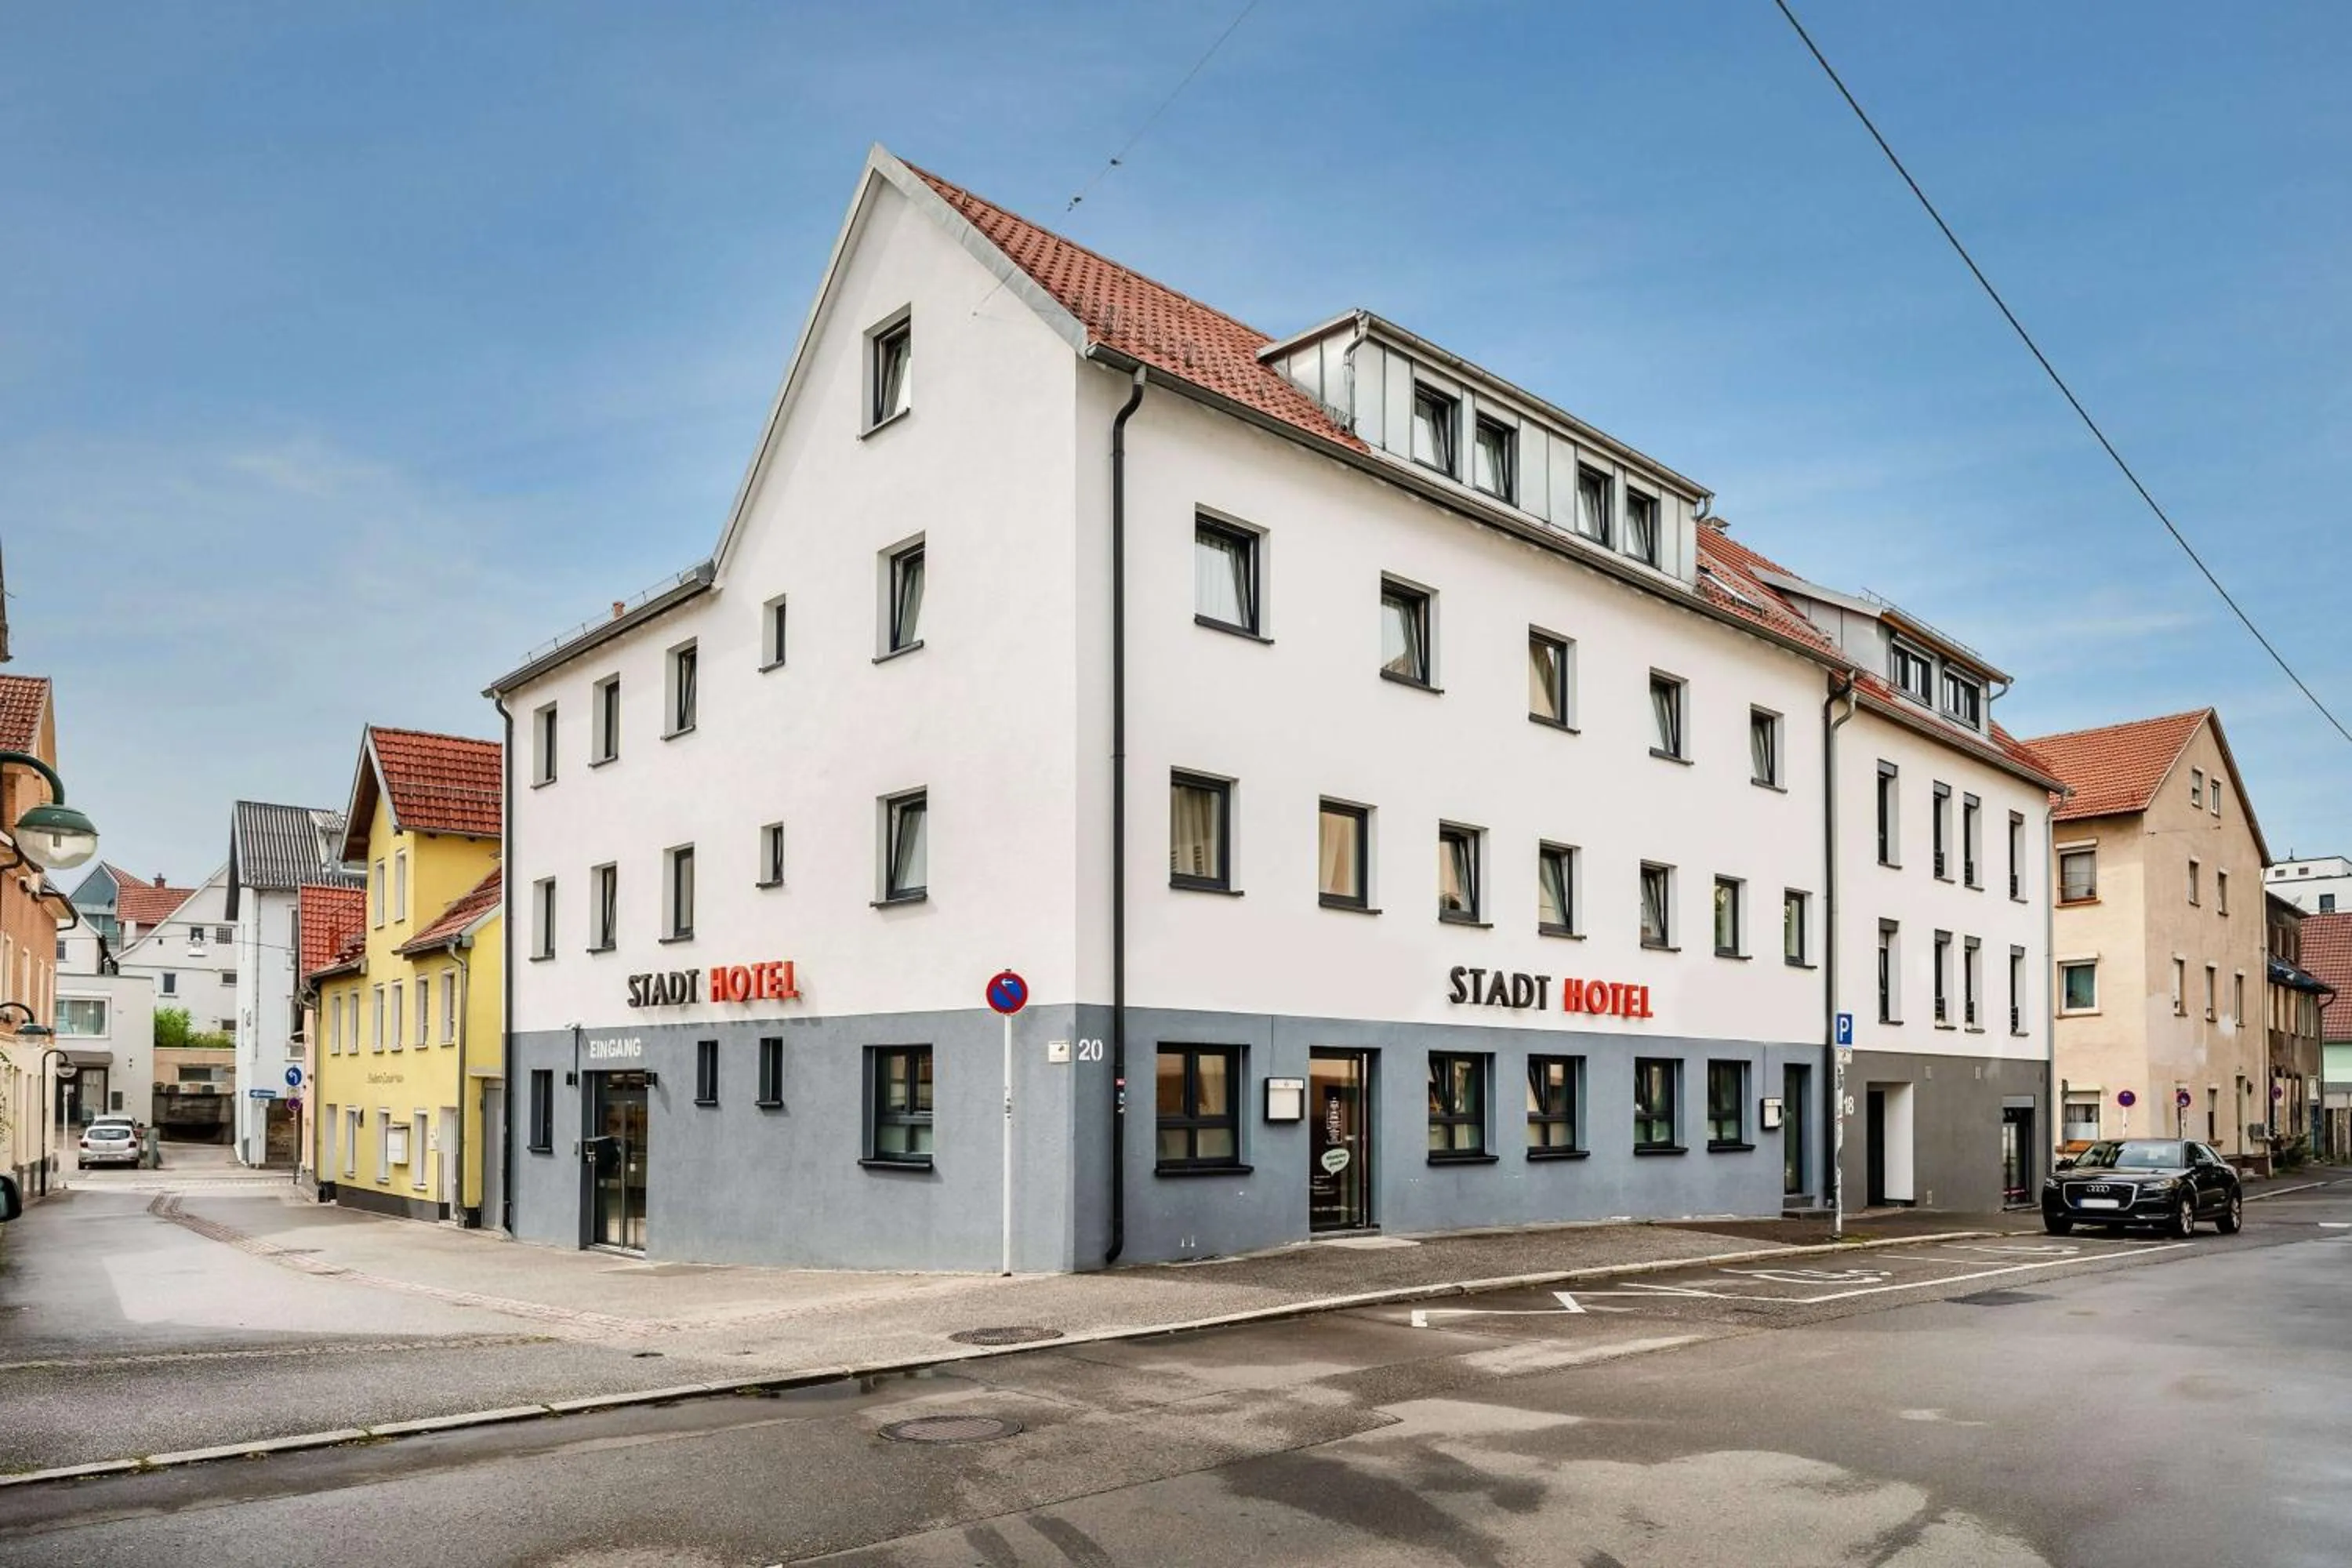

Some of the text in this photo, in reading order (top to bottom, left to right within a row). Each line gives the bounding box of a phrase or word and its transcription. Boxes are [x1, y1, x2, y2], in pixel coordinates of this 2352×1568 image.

[627, 960, 800, 1007] STADT HOTEL
[1449, 965, 1653, 1018] STADT HOTEL
[1839, 1017, 1849, 1042] P
[590, 1037, 641, 1059] EINGANG
[1078, 1038, 1104, 1061] 20
[1843, 1095, 1854, 1115] 18
